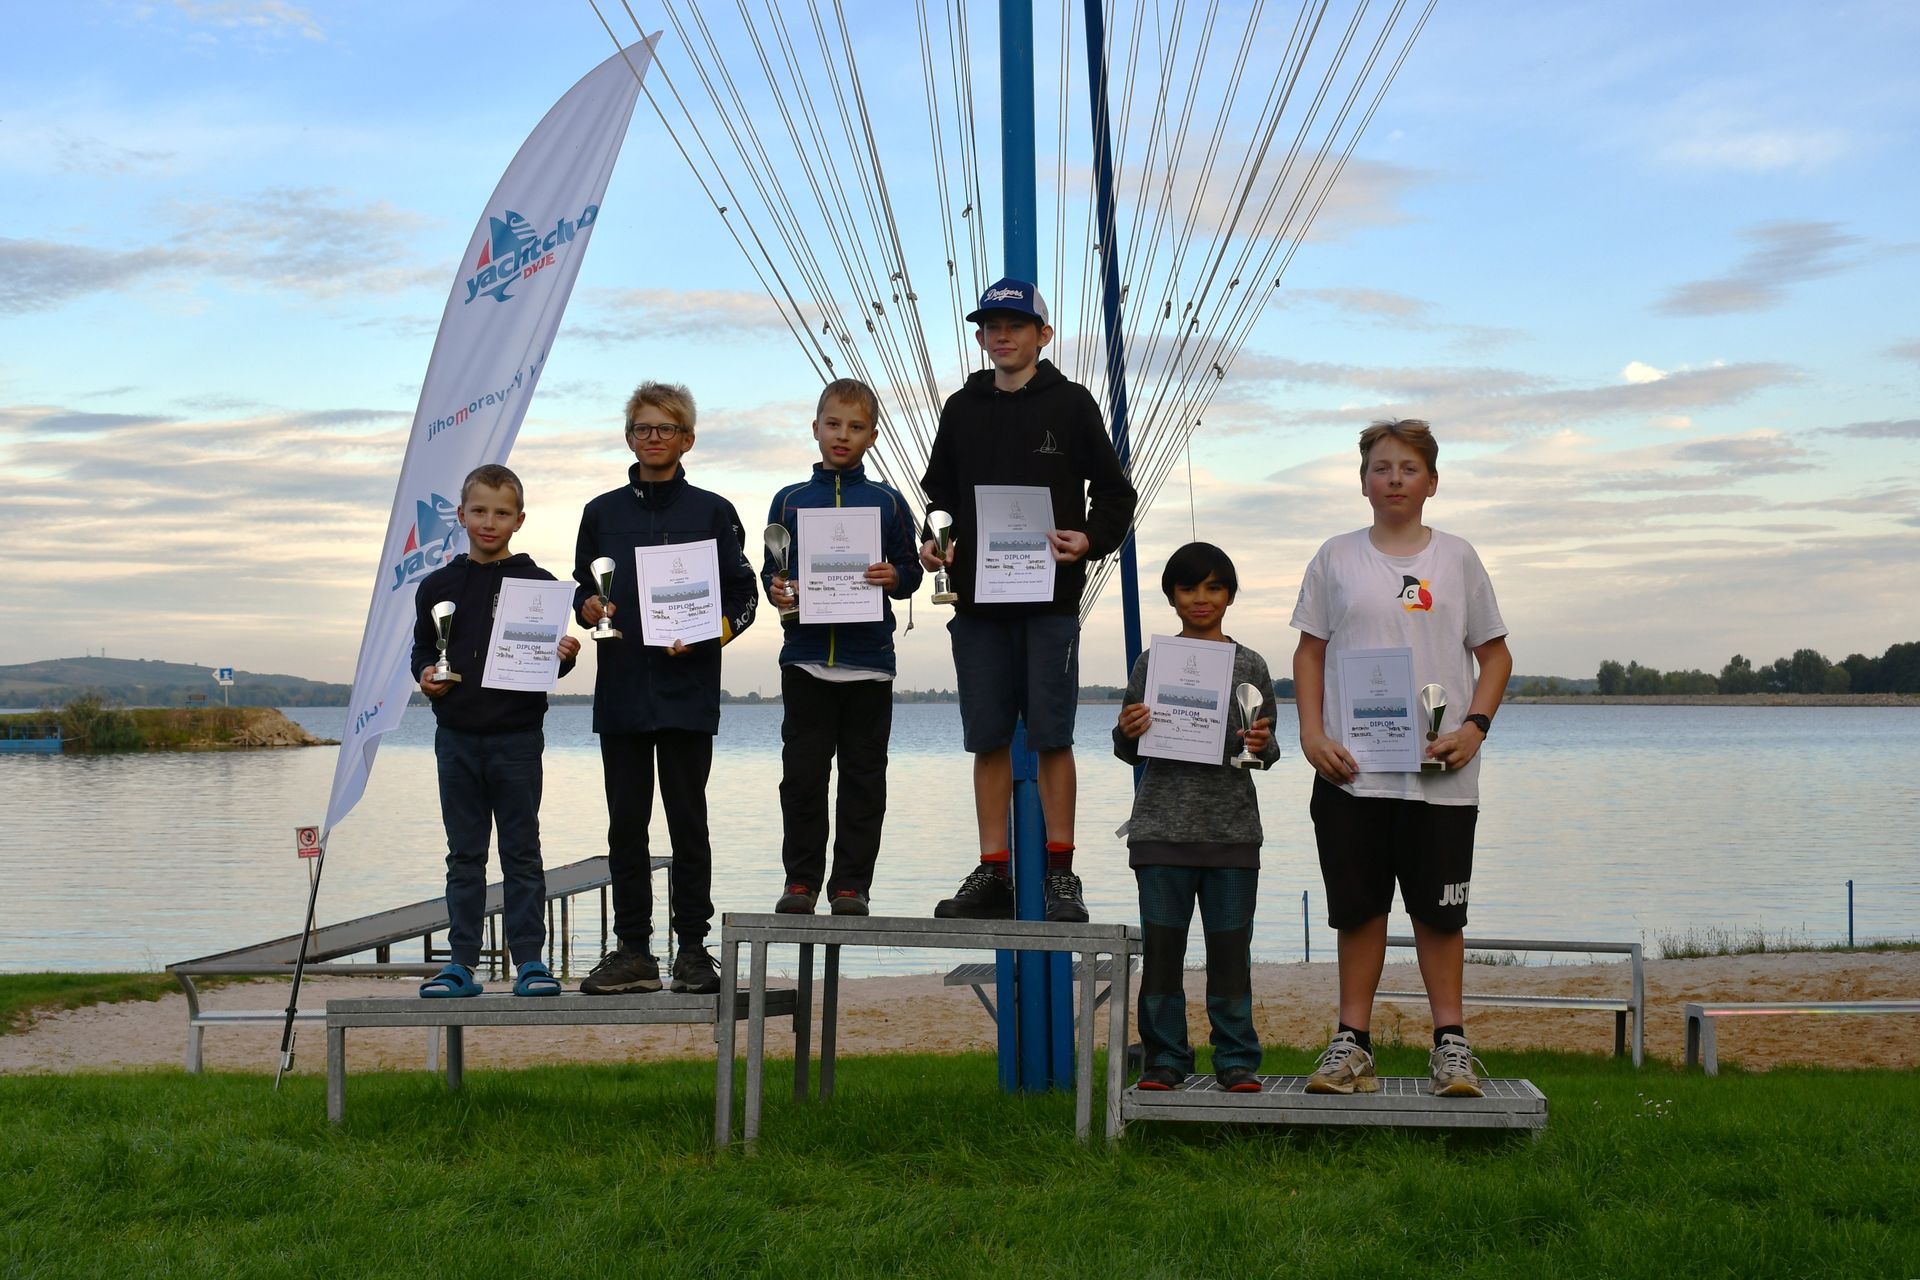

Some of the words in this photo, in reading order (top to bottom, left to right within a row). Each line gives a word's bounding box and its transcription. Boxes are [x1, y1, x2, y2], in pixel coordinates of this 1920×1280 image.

[984, 287, 1024, 303] Dodgers
[1407, 590, 1415, 599] C
[668, 602, 695, 611] DIPLOM
[516, 643, 541, 651] DIPLOM
[1172, 708, 1200, 718] DIPLOM
[1438, 881, 1470, 906] JUST
